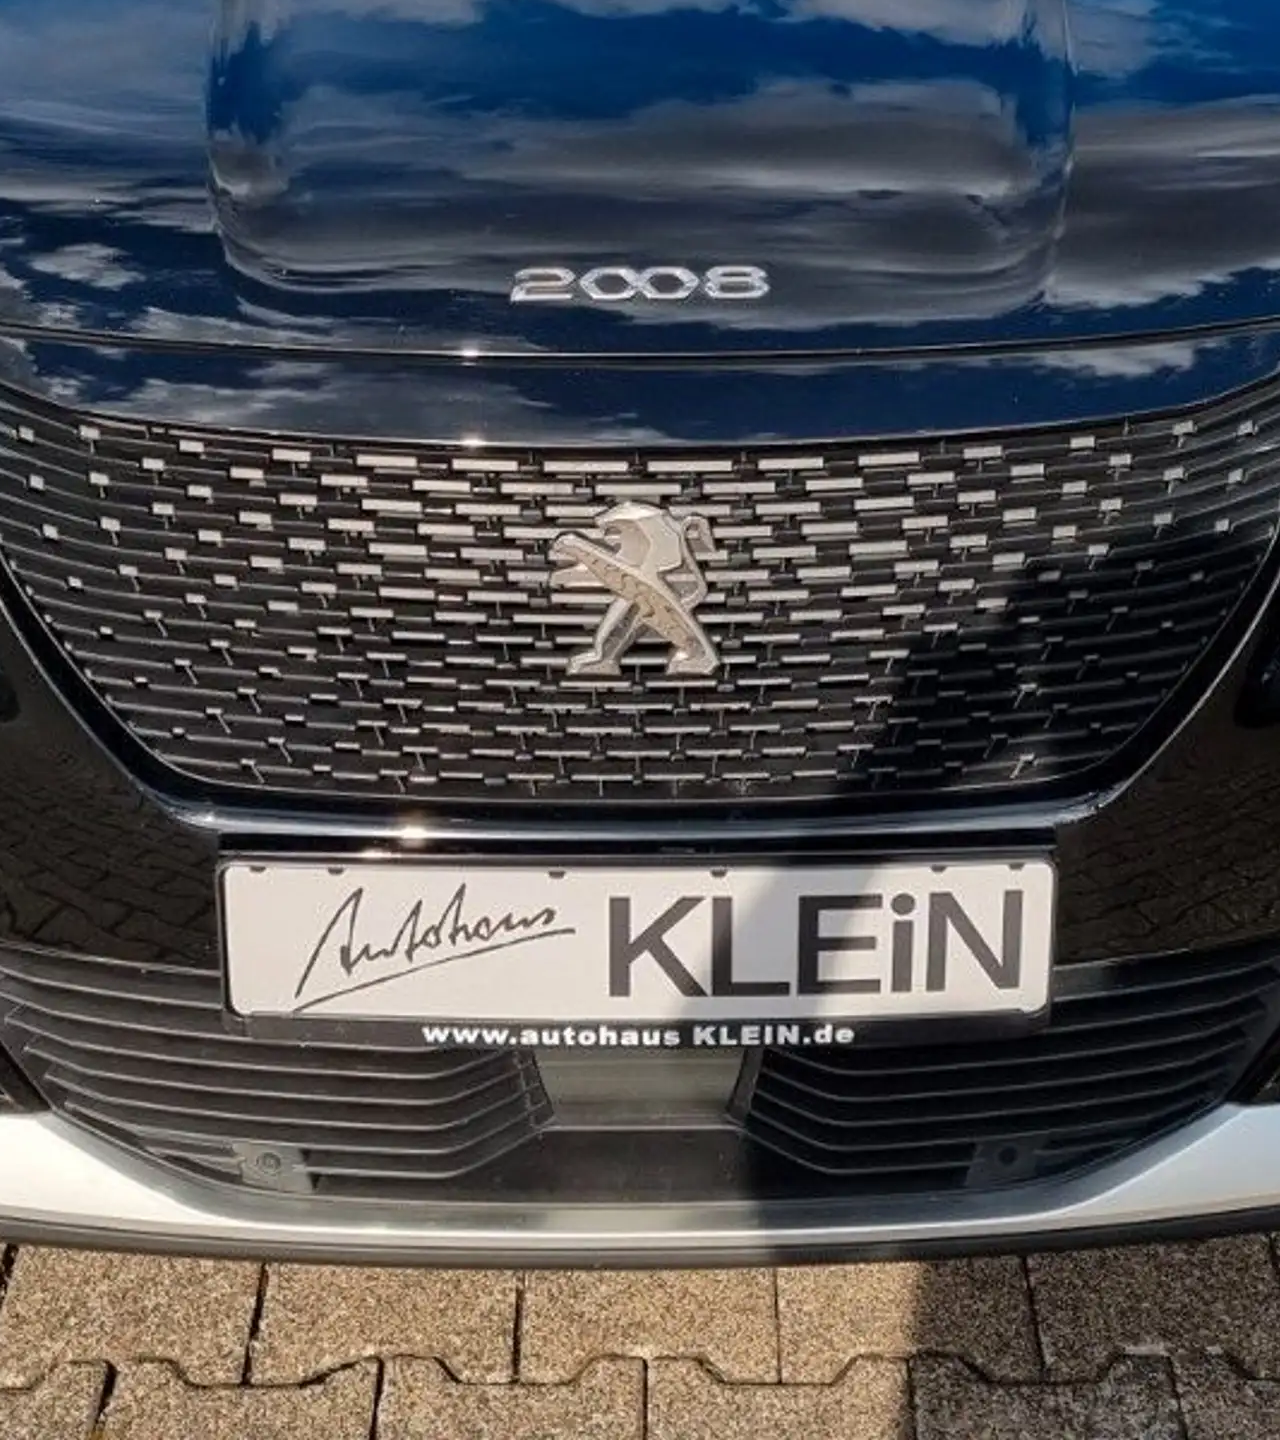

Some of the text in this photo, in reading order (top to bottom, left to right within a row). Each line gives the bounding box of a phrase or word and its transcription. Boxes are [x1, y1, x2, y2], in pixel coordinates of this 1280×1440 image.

[510, 265, 771, 302] 2008
[293, 882, 576, 1012] Autohaus
[422, 1023, 856, 1047] www.autohaus KLEIN.de
